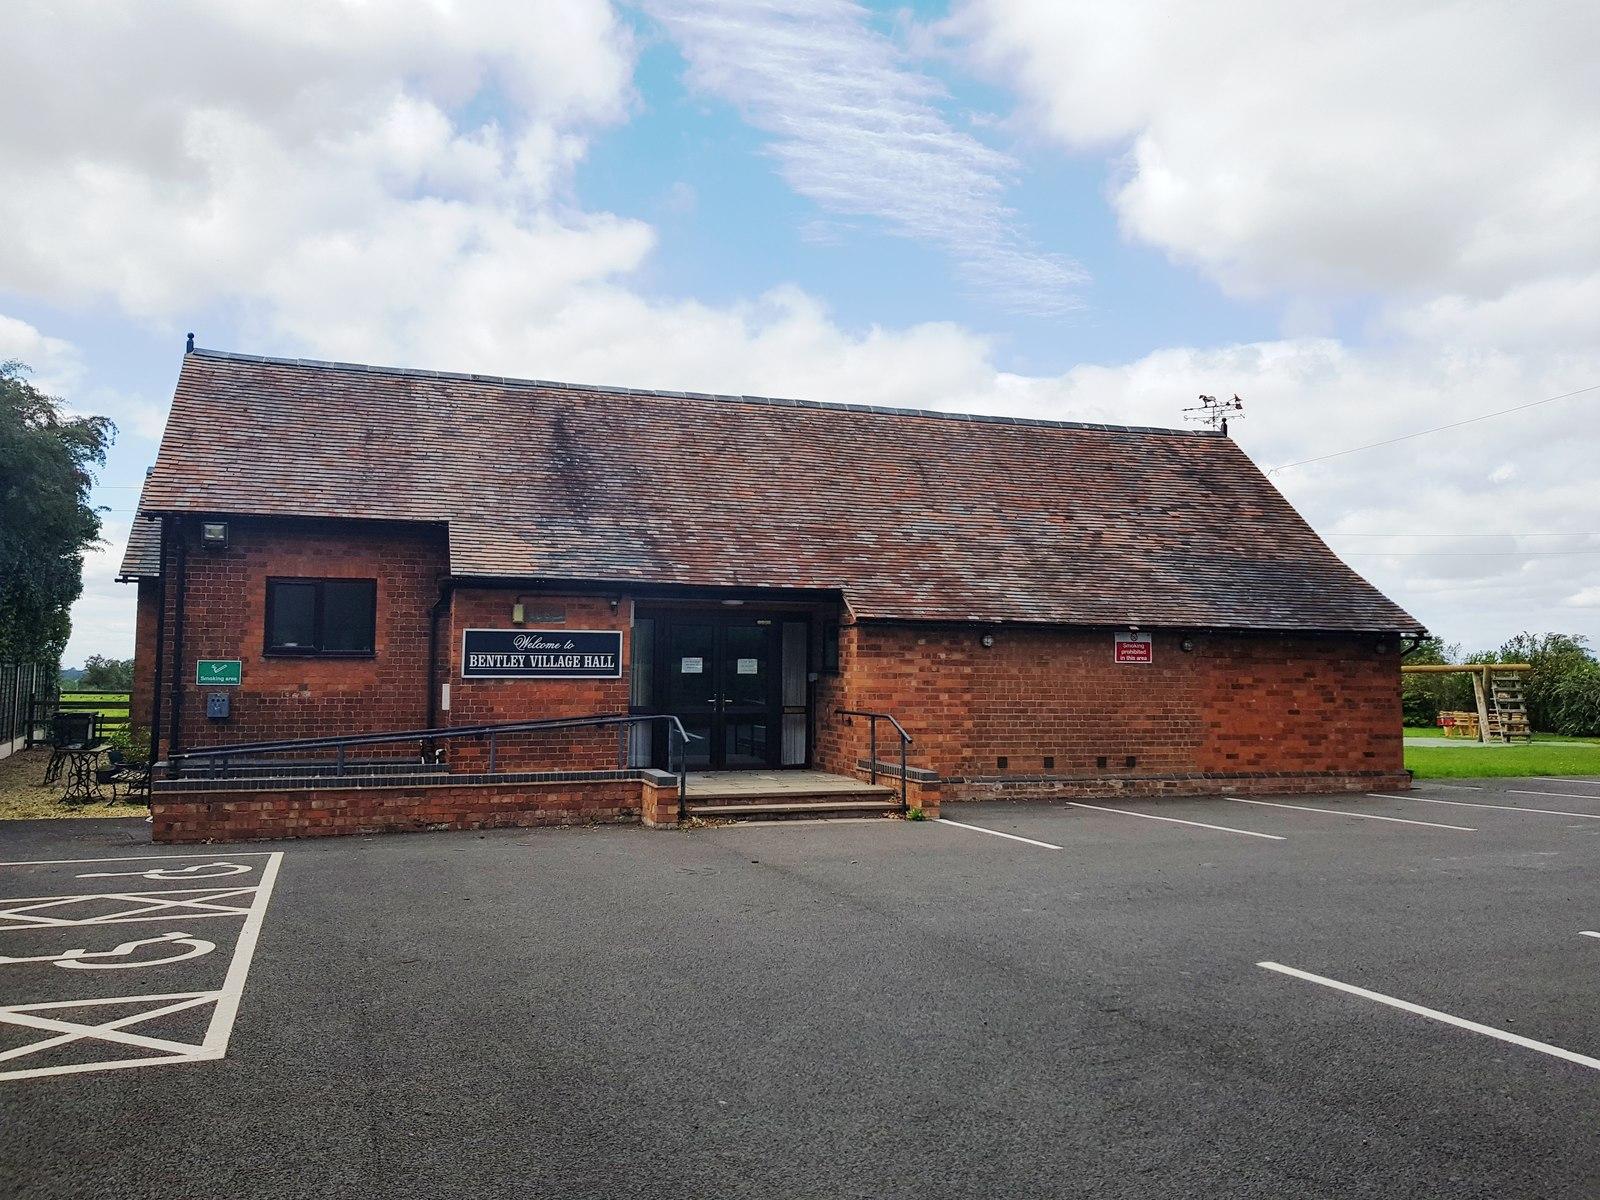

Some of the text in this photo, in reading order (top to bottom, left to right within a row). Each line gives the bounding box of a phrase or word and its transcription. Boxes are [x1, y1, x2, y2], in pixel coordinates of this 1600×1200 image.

[513, 634, 575, 651] Welcome to
[469, 655, 615, 668] BENTLEY VILLAGE HALL
